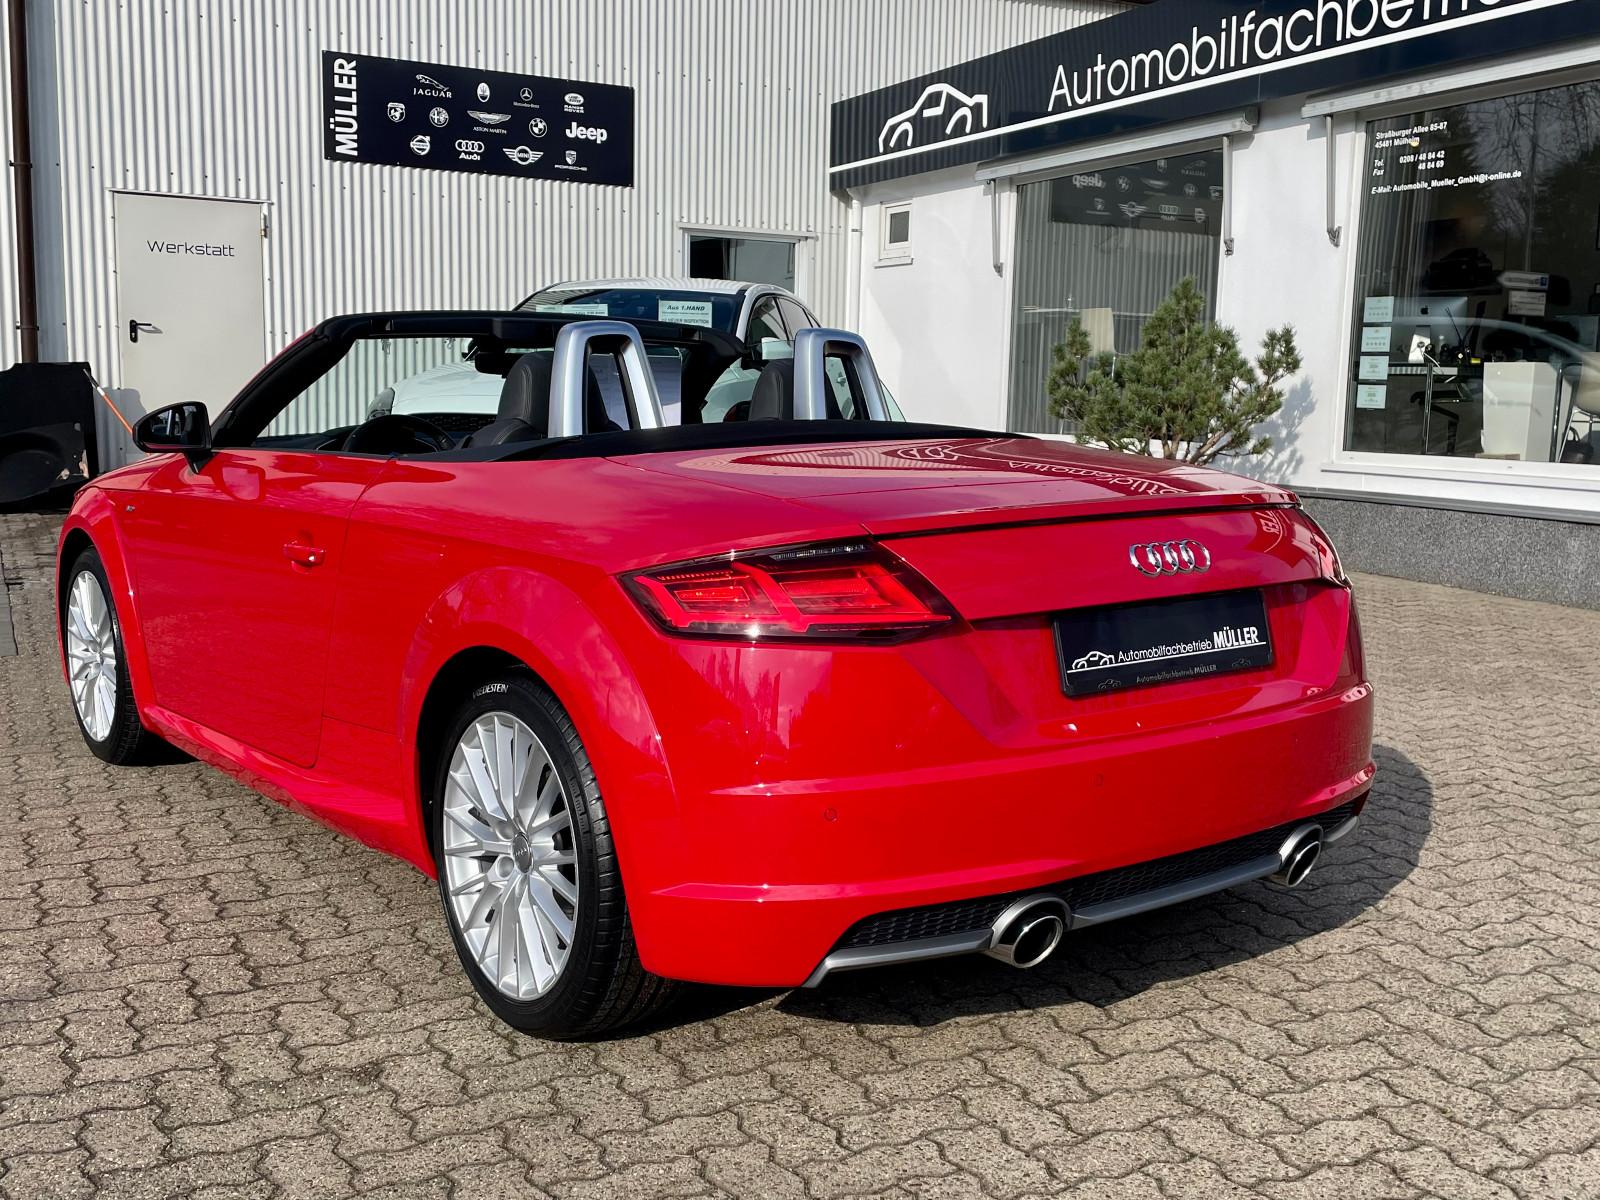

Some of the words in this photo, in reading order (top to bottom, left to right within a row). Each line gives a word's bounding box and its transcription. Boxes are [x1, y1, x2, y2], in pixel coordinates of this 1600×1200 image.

[1047, 0, 1501, 112] Automobilfachbe
[413, 87, 452, 98] JAGUAR
[329, 58, 358, 156] MÜLLER
[565, 121, 608, 144] Jeep
[1375, 128, 1412, 140] Straßburger
[1412, 125, 1429, 134] Allee
[1430, 121, 1448, 131] 85-87
[1374, 139, 1393, 149] 45481
[459, 152, 481, 160] Audi
[1399, 154, 1415, 164] 0208
[1418, 152, 1427, 160] 48
[1427, 151, 1436, 160] 84
[1436, 150, 1445, 158] 42
[1372, 168, 1385, 176] Fax
[1418, 162, 1426, 170] 48
[1427, 161, 1435, 169] 84
[146, 240, 235, 257] Werkstatt
[1117, 639, 1213, 663] Automobilfachbetrieb
[1213, 626, 1259, 649] MÜLLER
